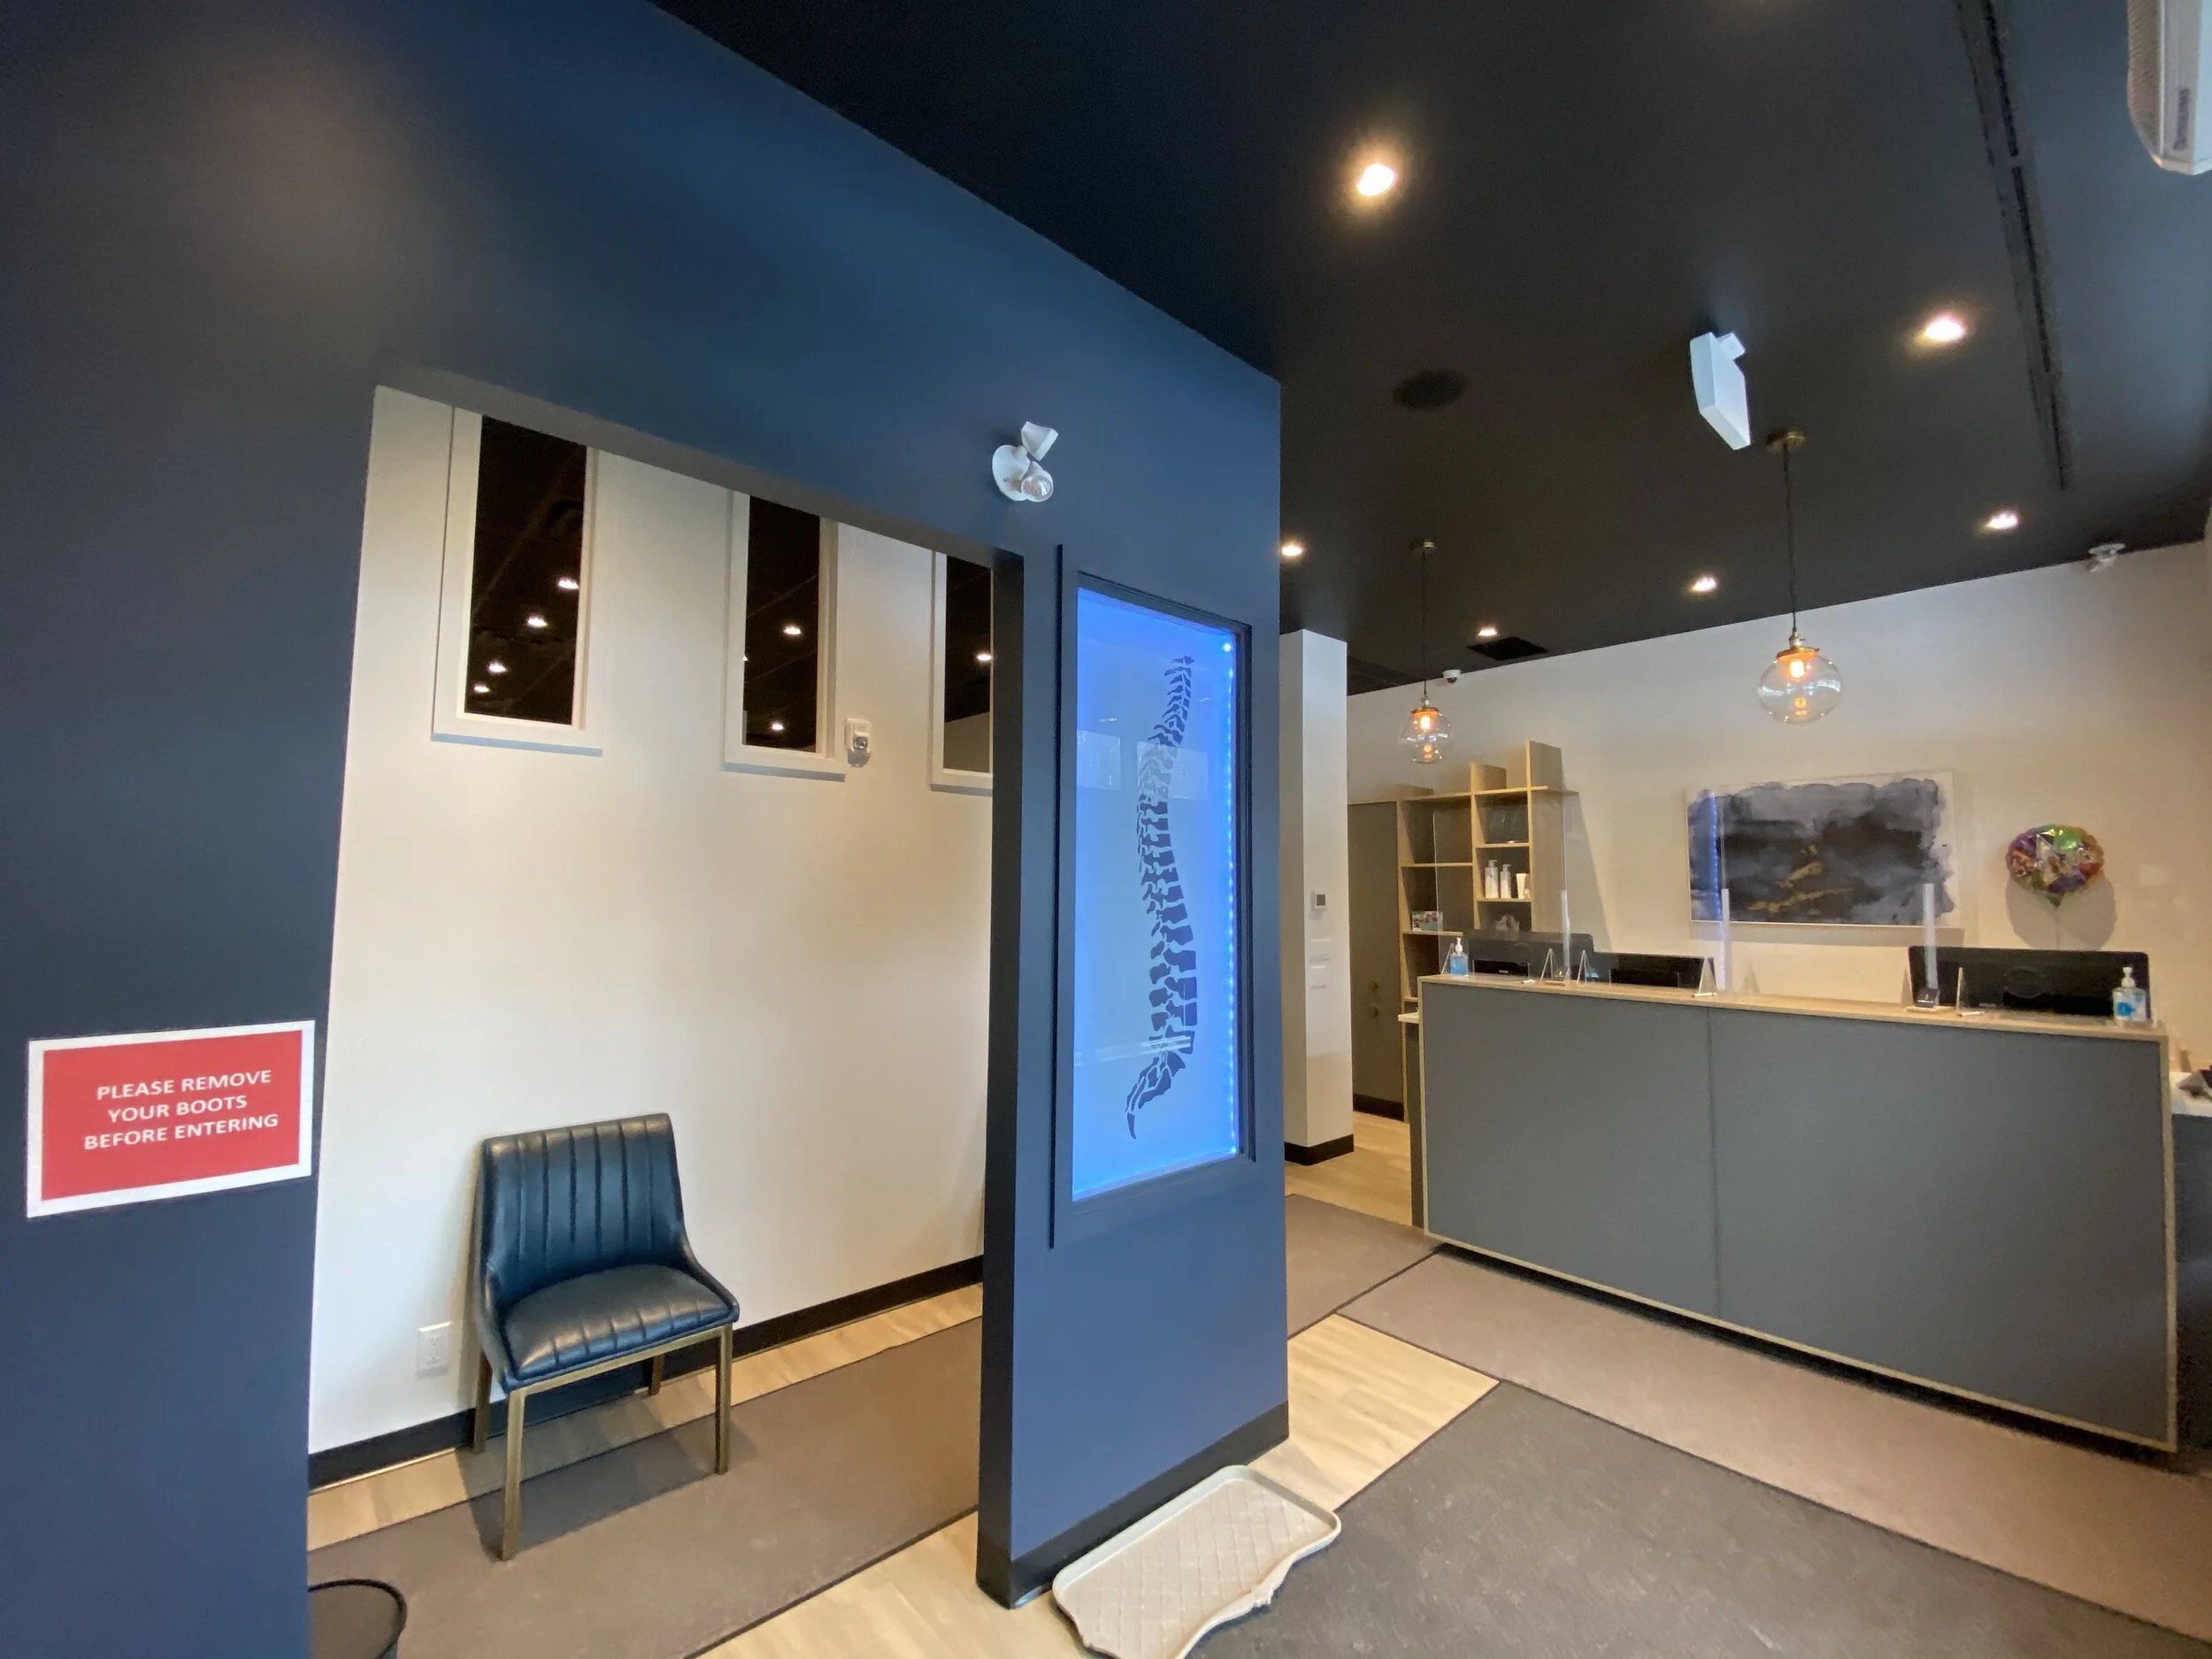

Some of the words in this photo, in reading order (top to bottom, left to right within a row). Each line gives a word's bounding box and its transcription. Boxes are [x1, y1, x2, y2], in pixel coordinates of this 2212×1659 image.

[97, 1079, 174, 1101] PLEASE
[180, 1069, 272, 1093] REMOVE
[108, 1103, 170, 1124] YOUR
[176, 1094, 248, 1116] BOOTS
[84, 1126, 168, 1150] BEFORE
[174, 1113, 279, 1140] ENTERING
